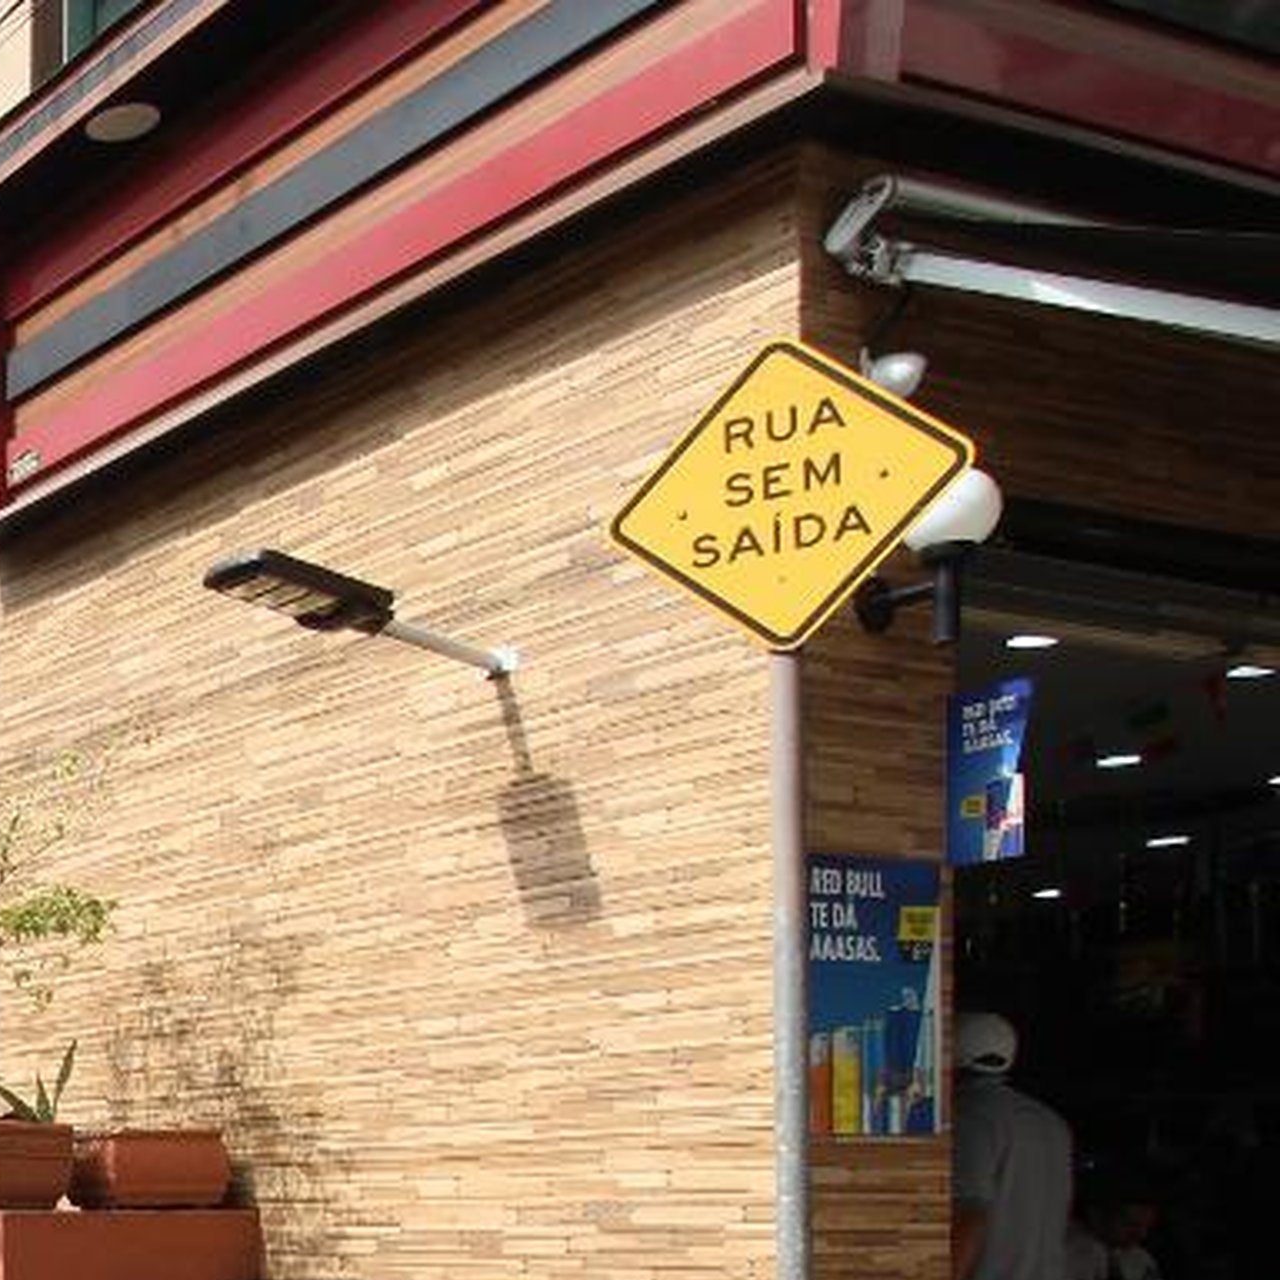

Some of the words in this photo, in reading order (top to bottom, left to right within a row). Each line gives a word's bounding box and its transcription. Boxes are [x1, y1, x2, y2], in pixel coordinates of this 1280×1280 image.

[723, 397, 846, 453] RUA
[724, 452, 842, 507] SEM
[691, 504, 872, 568] SAÍDA
[810, 866, 842, 895] RED
[845, 868, 887, 898] BULL
[810, 902, 829, 929] TE
